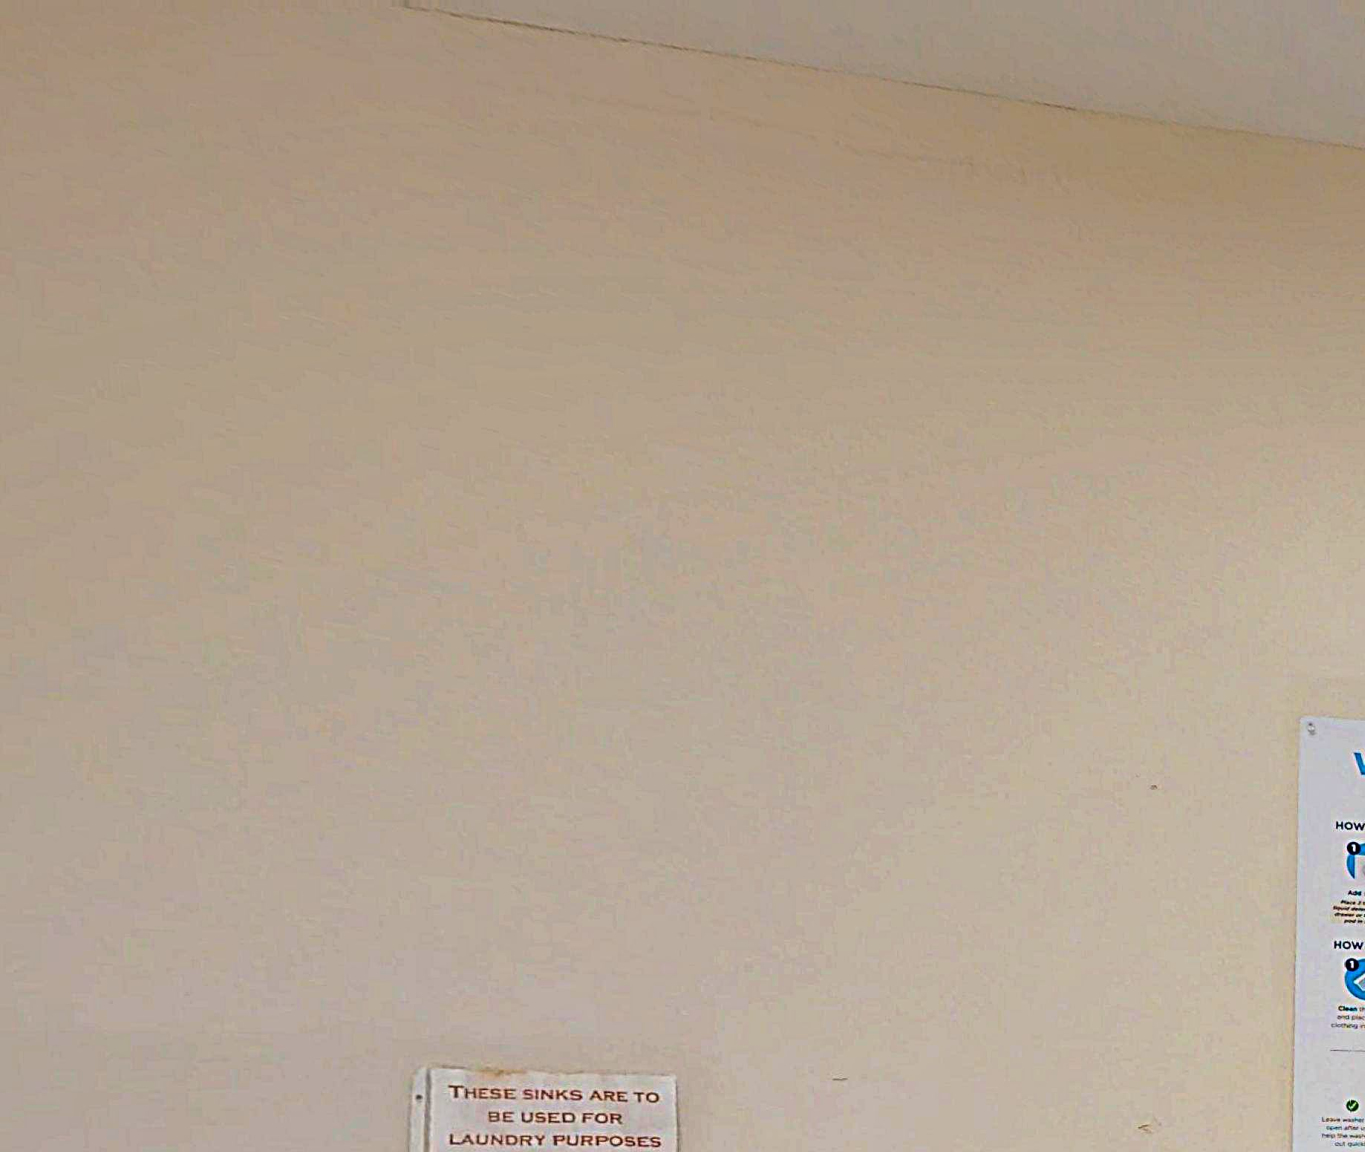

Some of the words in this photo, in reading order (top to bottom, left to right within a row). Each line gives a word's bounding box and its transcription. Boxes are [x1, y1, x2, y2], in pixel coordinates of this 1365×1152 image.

[1336, 821, 1365, 832] HOW
[1351, 843, 1356, 854] 1
[1334, 941, 1363, 950] HOW
[448, 1085, 517, 1101] THESE
[523, 1089, 583, 1100] SINKS
[589, 1090, 627, 1102] ARE
[633, 1092, 659, 1103] TO
[488, 1112, 514, 1123] BE
[521, 1112, 576, 1123] USED
[582, 1113, 623, 1124] FOR
[449, 1134, 545, 1146] LAUNDRY
[553, 1136, 661, 1147] PURPOSES
